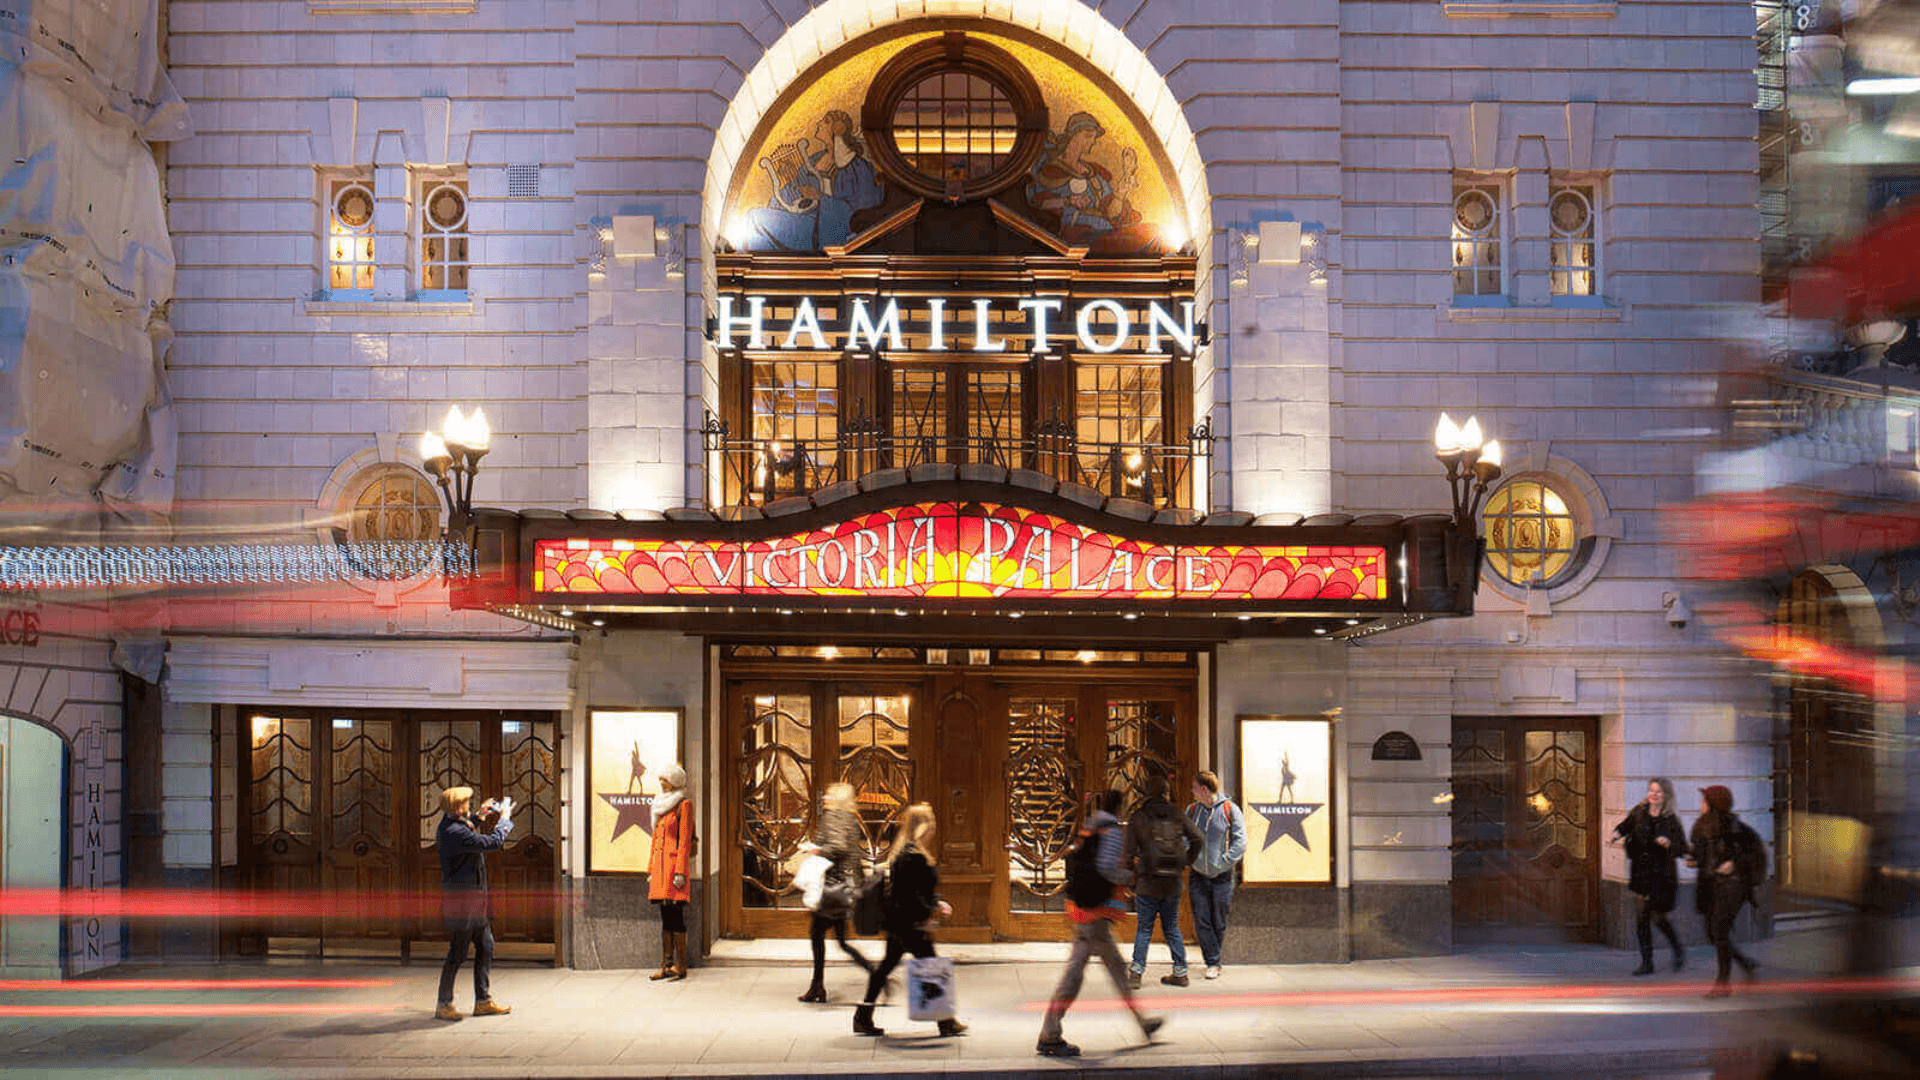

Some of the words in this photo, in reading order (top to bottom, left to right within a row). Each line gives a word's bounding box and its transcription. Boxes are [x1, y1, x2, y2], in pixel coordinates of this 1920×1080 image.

[716, 296, 1197, 354] HAMILTON
[703, 516, 935, 588] VICTORIA
[983, 517, 1214, 590] PALACE
[610, 796, 653, 805] HAMILTO
[1260, 806, 1311, 814] HAMILTON
[86, 783, 101, 960] HAMILON
